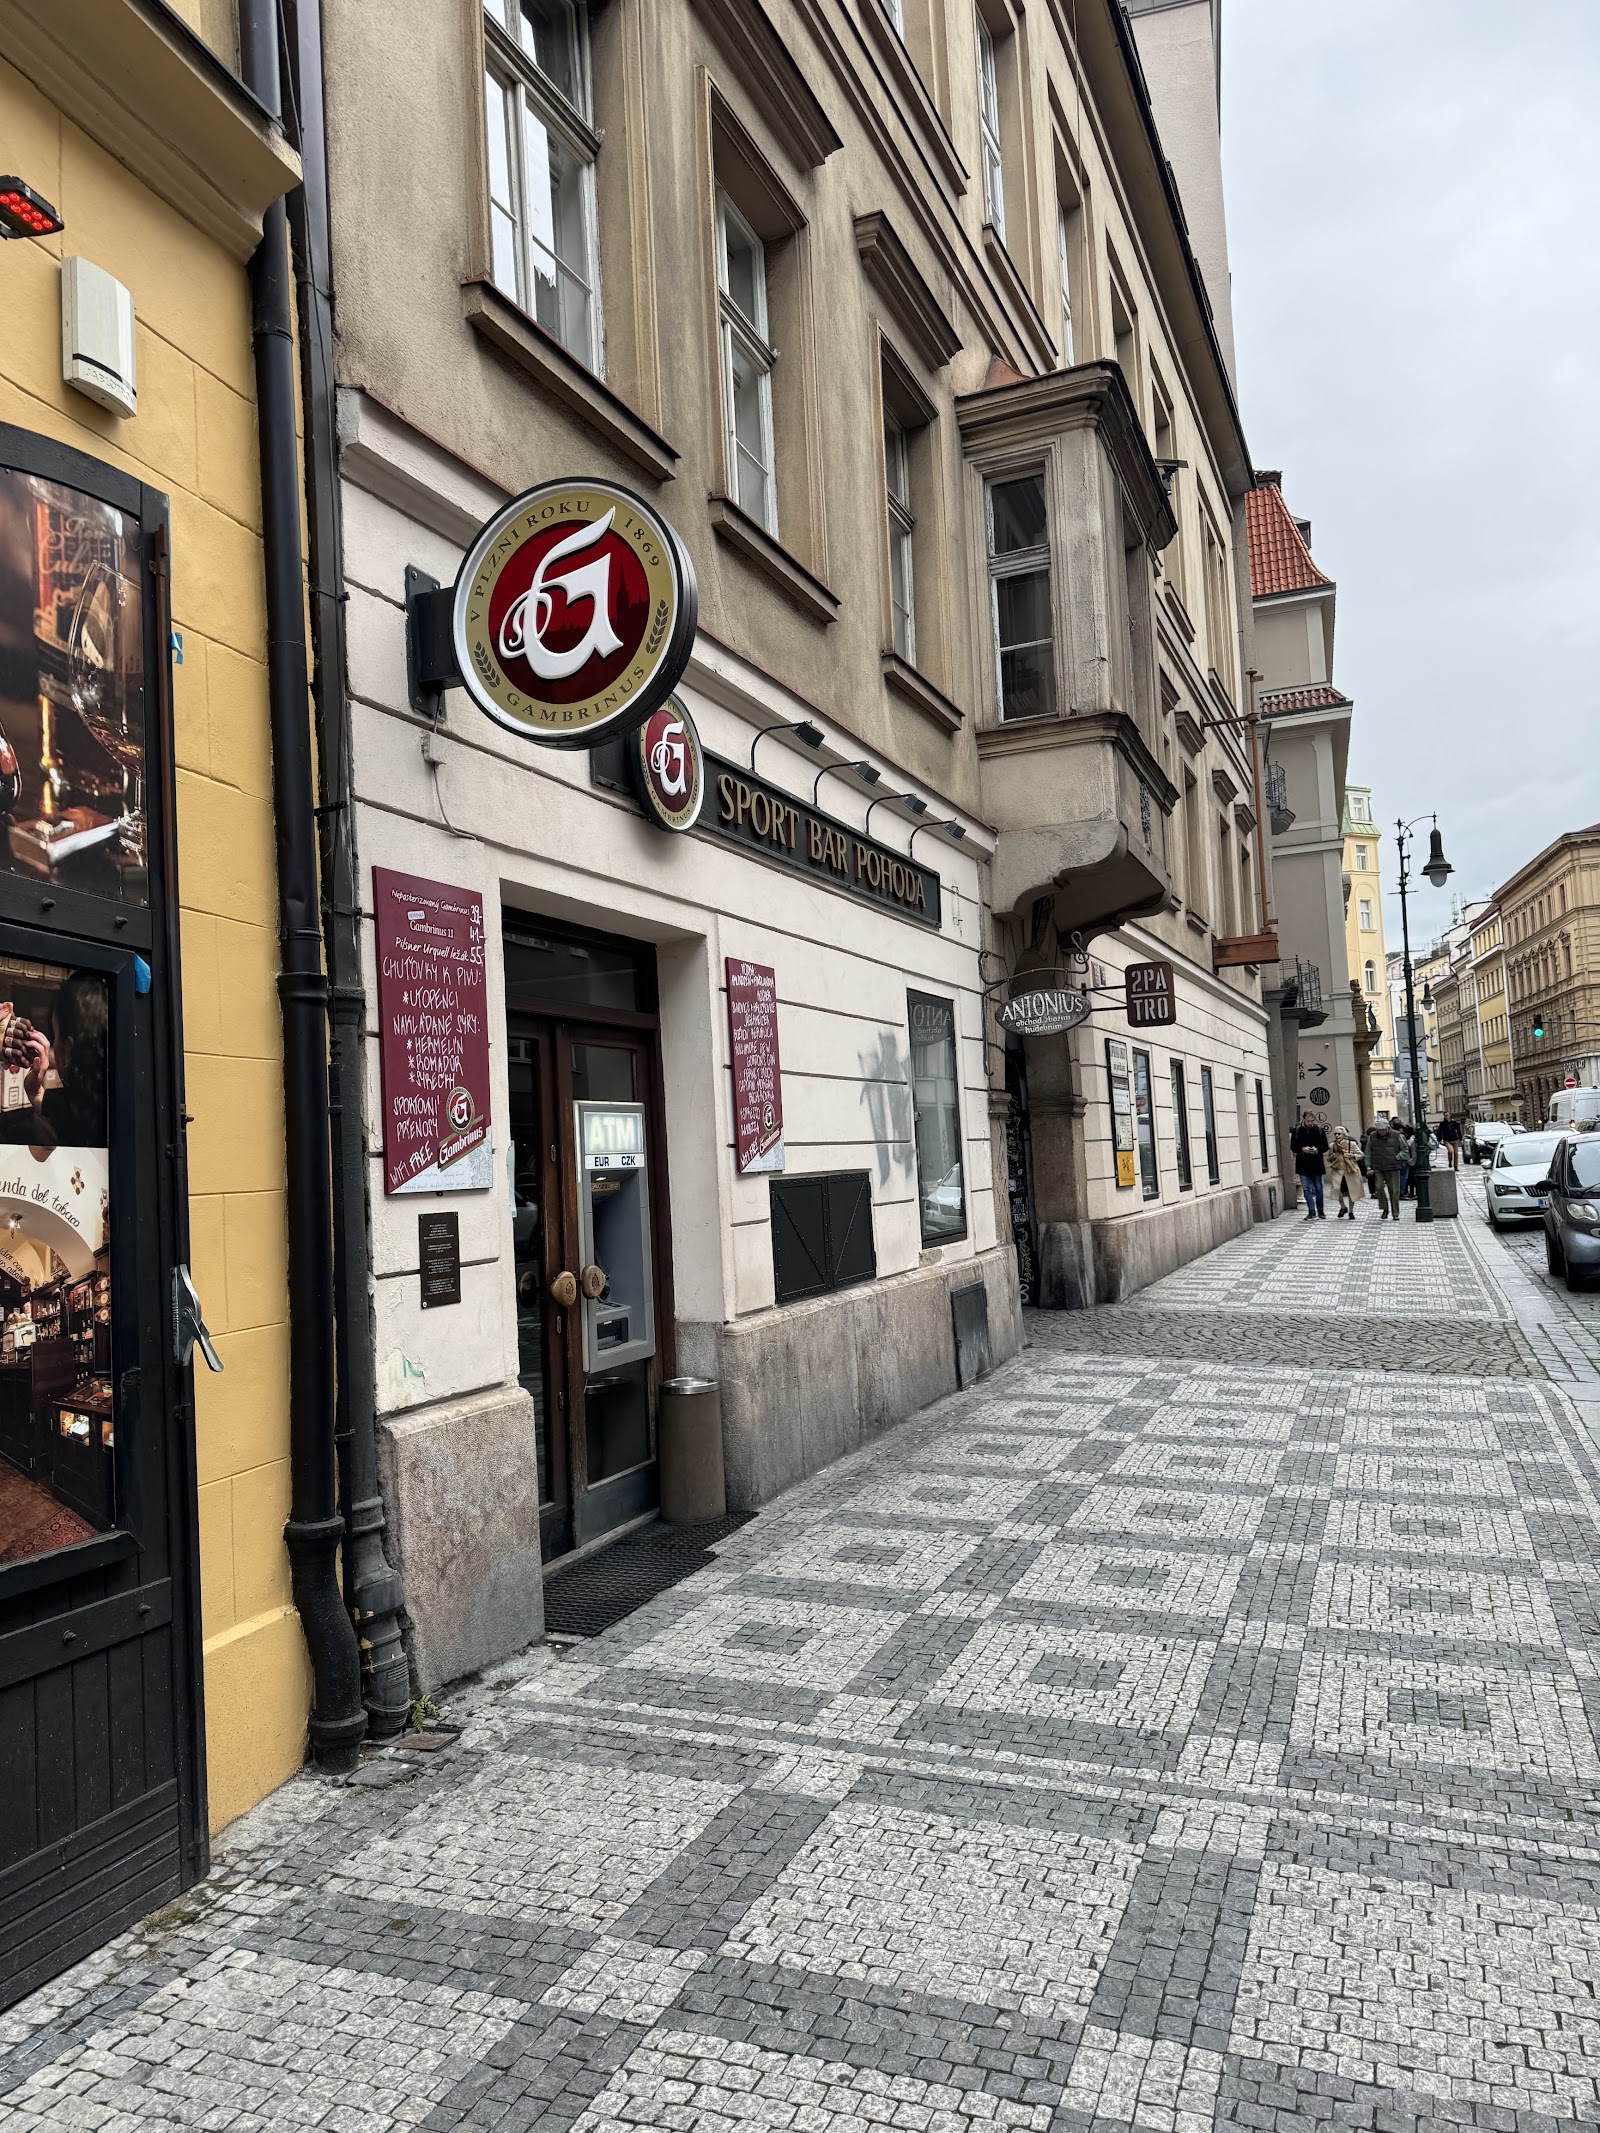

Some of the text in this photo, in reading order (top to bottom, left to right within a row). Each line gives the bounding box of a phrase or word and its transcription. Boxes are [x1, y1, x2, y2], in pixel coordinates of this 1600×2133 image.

[624, 517, 660, 566] 1869
[470, 500, 590, 623] V PLZNI ROKU
[506, 666, 645, 722] GAMBRINUS
[651, 790, 691, 824] GAMBRINUS
[718, 773, 927, 909] SPORT BAR POHODA
[409, 920, 447, 937] Gambrinus
[395, 936, 421, 953] Pilsner
[423, 943, 450, 961] Urquell
[442, 966, 451, 985] K
[456, 966, 482, 986] PIVU:
[1131, 967, 1167, 992] 2PA
[1002, 992, 1083, 1021] ANTONIUS
[1015, 1017, 1042, 1028] obchod
[1132, 997, 1169, 1021] TRO
[439, 1126, 483, 1165] Gambrinus
[589, 1116, 635, 1151] ATM
[409, 1140, 433, 1173] FREE
[594, 1155, 636, 1167] EUR CZK
[0, 1177, 80, 1228] nda del tabaco
